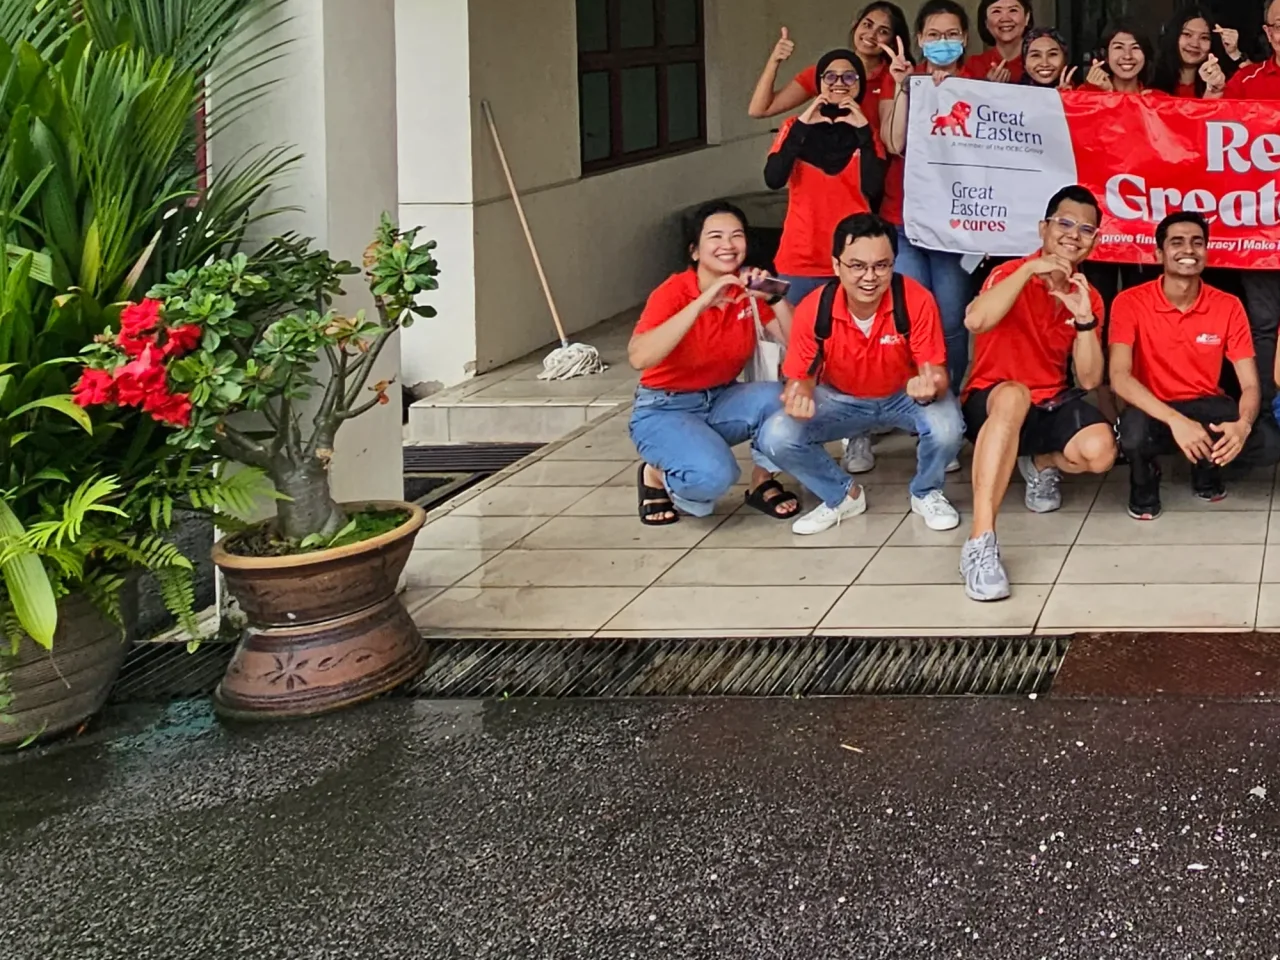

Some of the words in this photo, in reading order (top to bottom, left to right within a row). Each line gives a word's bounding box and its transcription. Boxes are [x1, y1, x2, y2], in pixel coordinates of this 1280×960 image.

[976, 104, 1025, 127] Great
[975, 122, 1043, 145] Eastern
[951, 181, 994, 200] Great
[950, 198, 1008, 218] Eastern
[962, 219, 1006, 232] cares
[1099, 233, 1133, 244] prove
[1207, 240, 1237, 252] racy
[1243, 239, 1275, 250] Make
